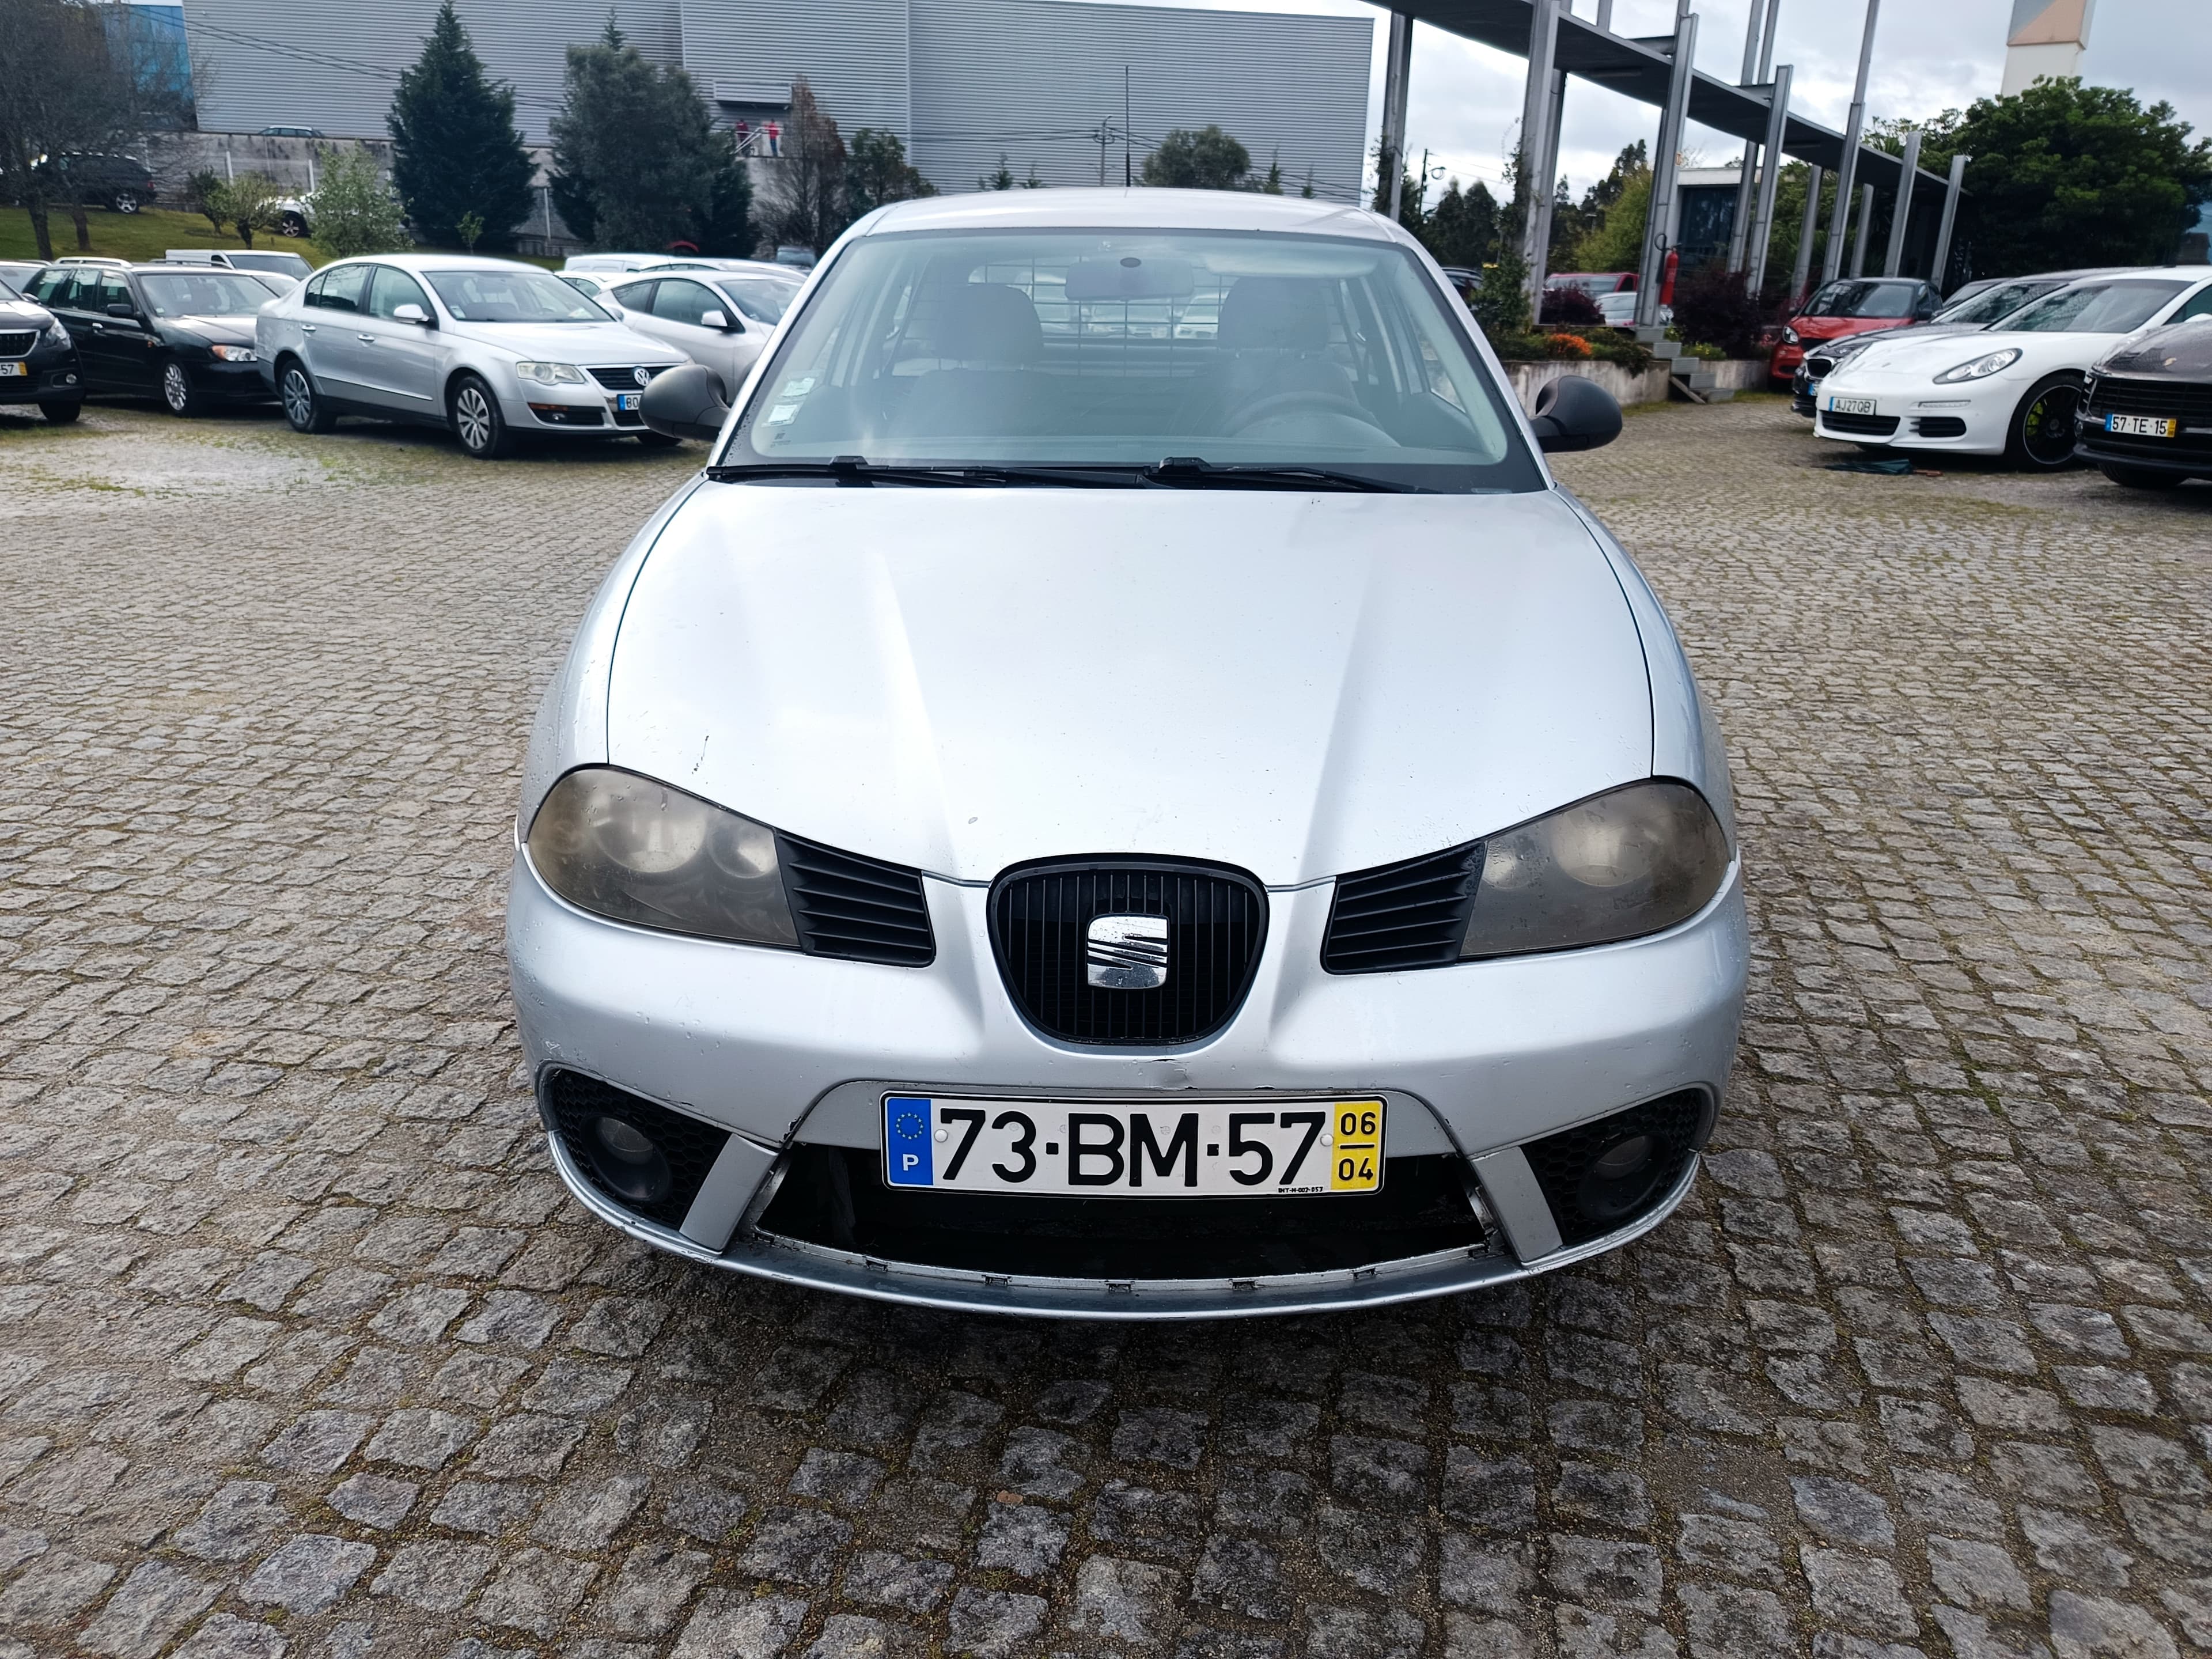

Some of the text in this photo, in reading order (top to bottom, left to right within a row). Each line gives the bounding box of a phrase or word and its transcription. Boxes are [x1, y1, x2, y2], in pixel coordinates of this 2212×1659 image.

[1340, 1112, 1376, 1135] 06
[903, 1153, 919, 1171] P
[1338, 1157, 1373, 1181] 04
